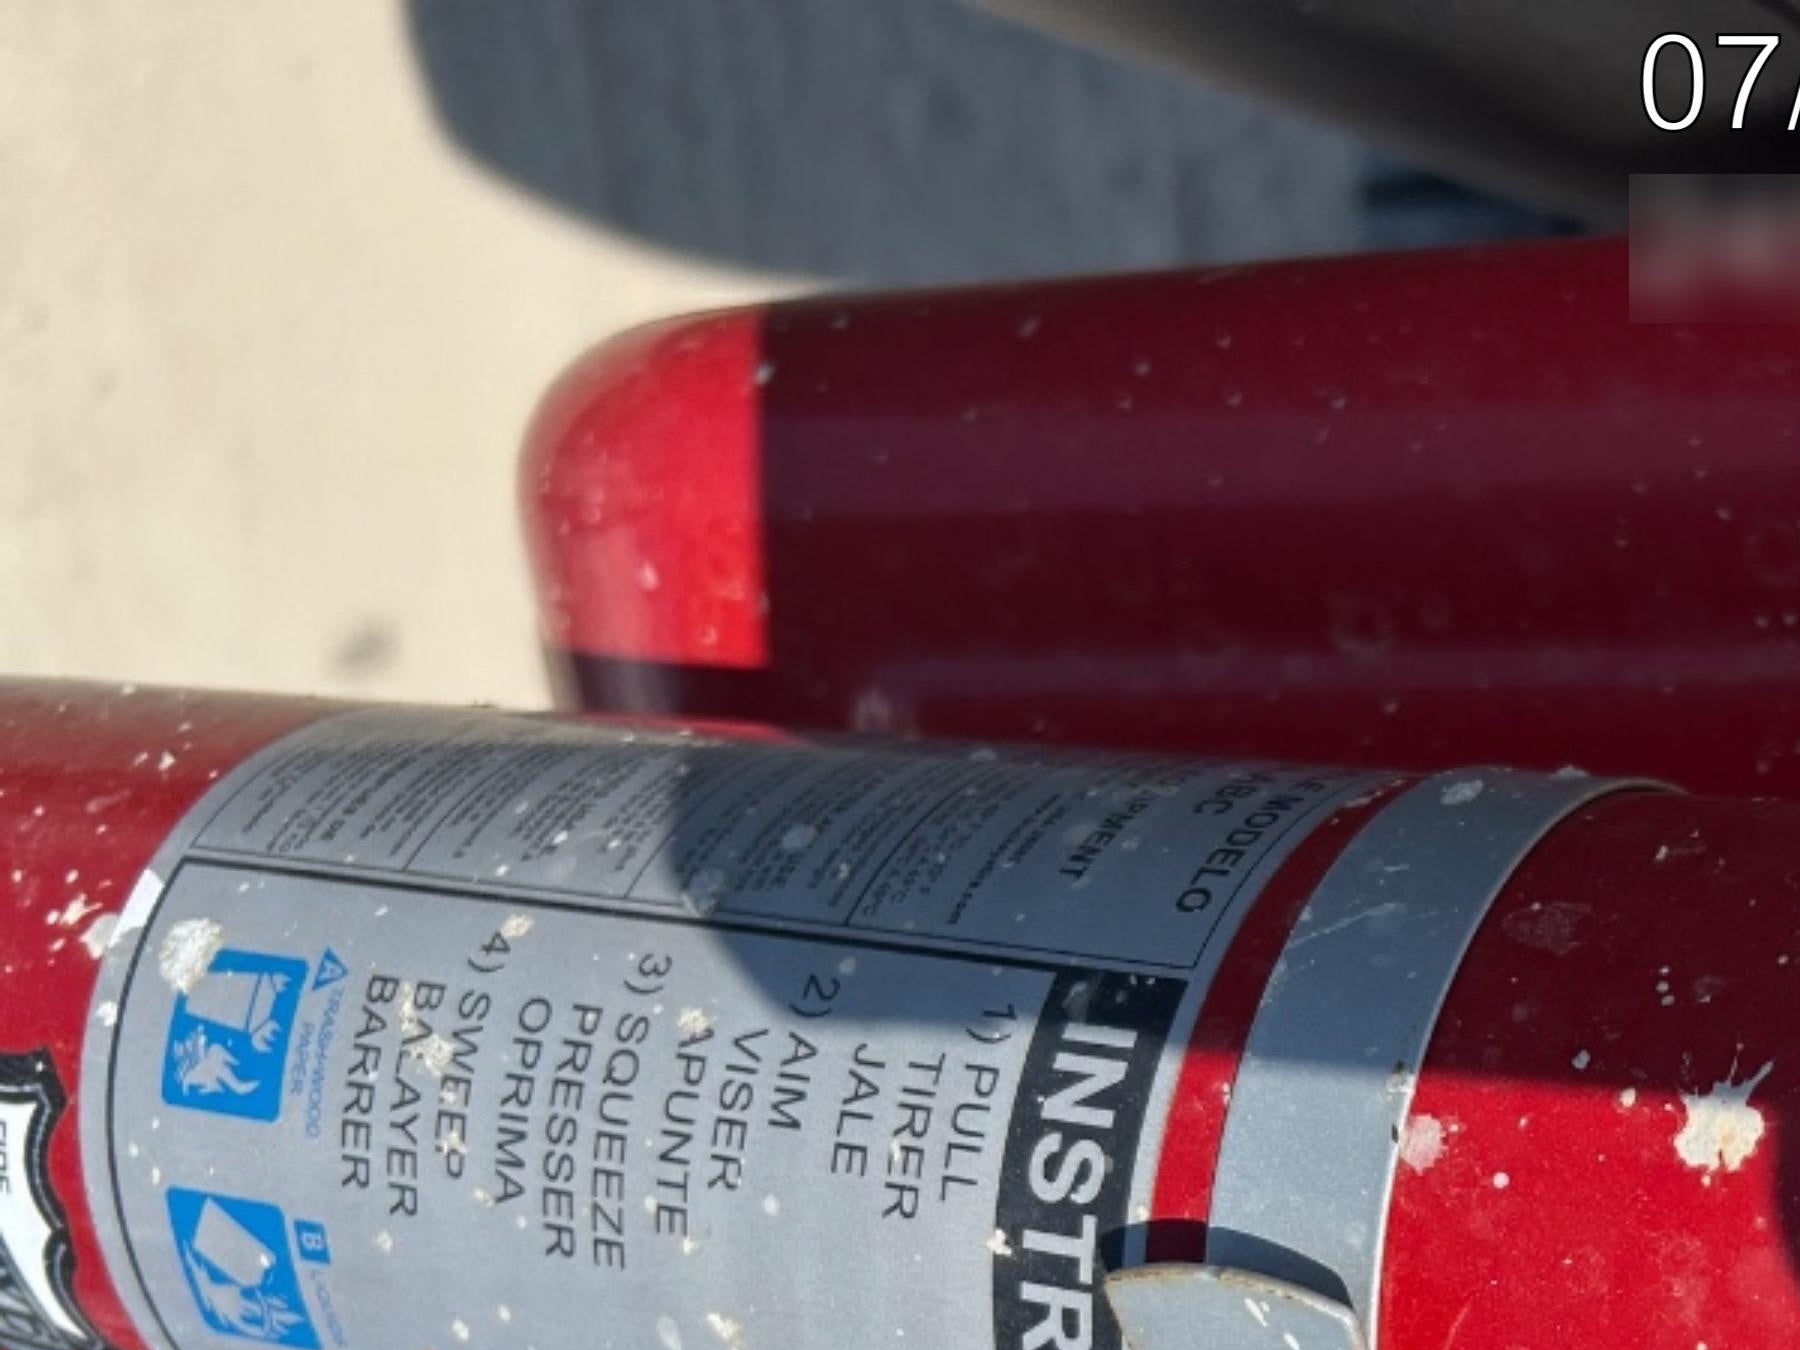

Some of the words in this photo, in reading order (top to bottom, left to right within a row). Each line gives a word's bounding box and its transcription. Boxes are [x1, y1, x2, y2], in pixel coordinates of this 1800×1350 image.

[466, 929, 512, 974] 4)
[623, 952, 673, 996] 3)
[788, 972, 841, 1019] 2)
[340, 972, 400, 1189] BARRER
[434, 988, 493, 1180] SWEEP
[494, 997, 553, 1205] OPRIMA
[541, 1003, 603, 1259] PRESSER
[590, 1012, 650, 1271] SQUEEZE
[655, 1027, 715, 1238] APUNTE
[706, 1027, 770, 1192] VISER
[767, 1030, 820, 1131] AIM
[830, 1042, 886, 1177] JALE
[881, 1052, 947, 1219] TIRER
[938, 1062, 1001, 1202] PULL
